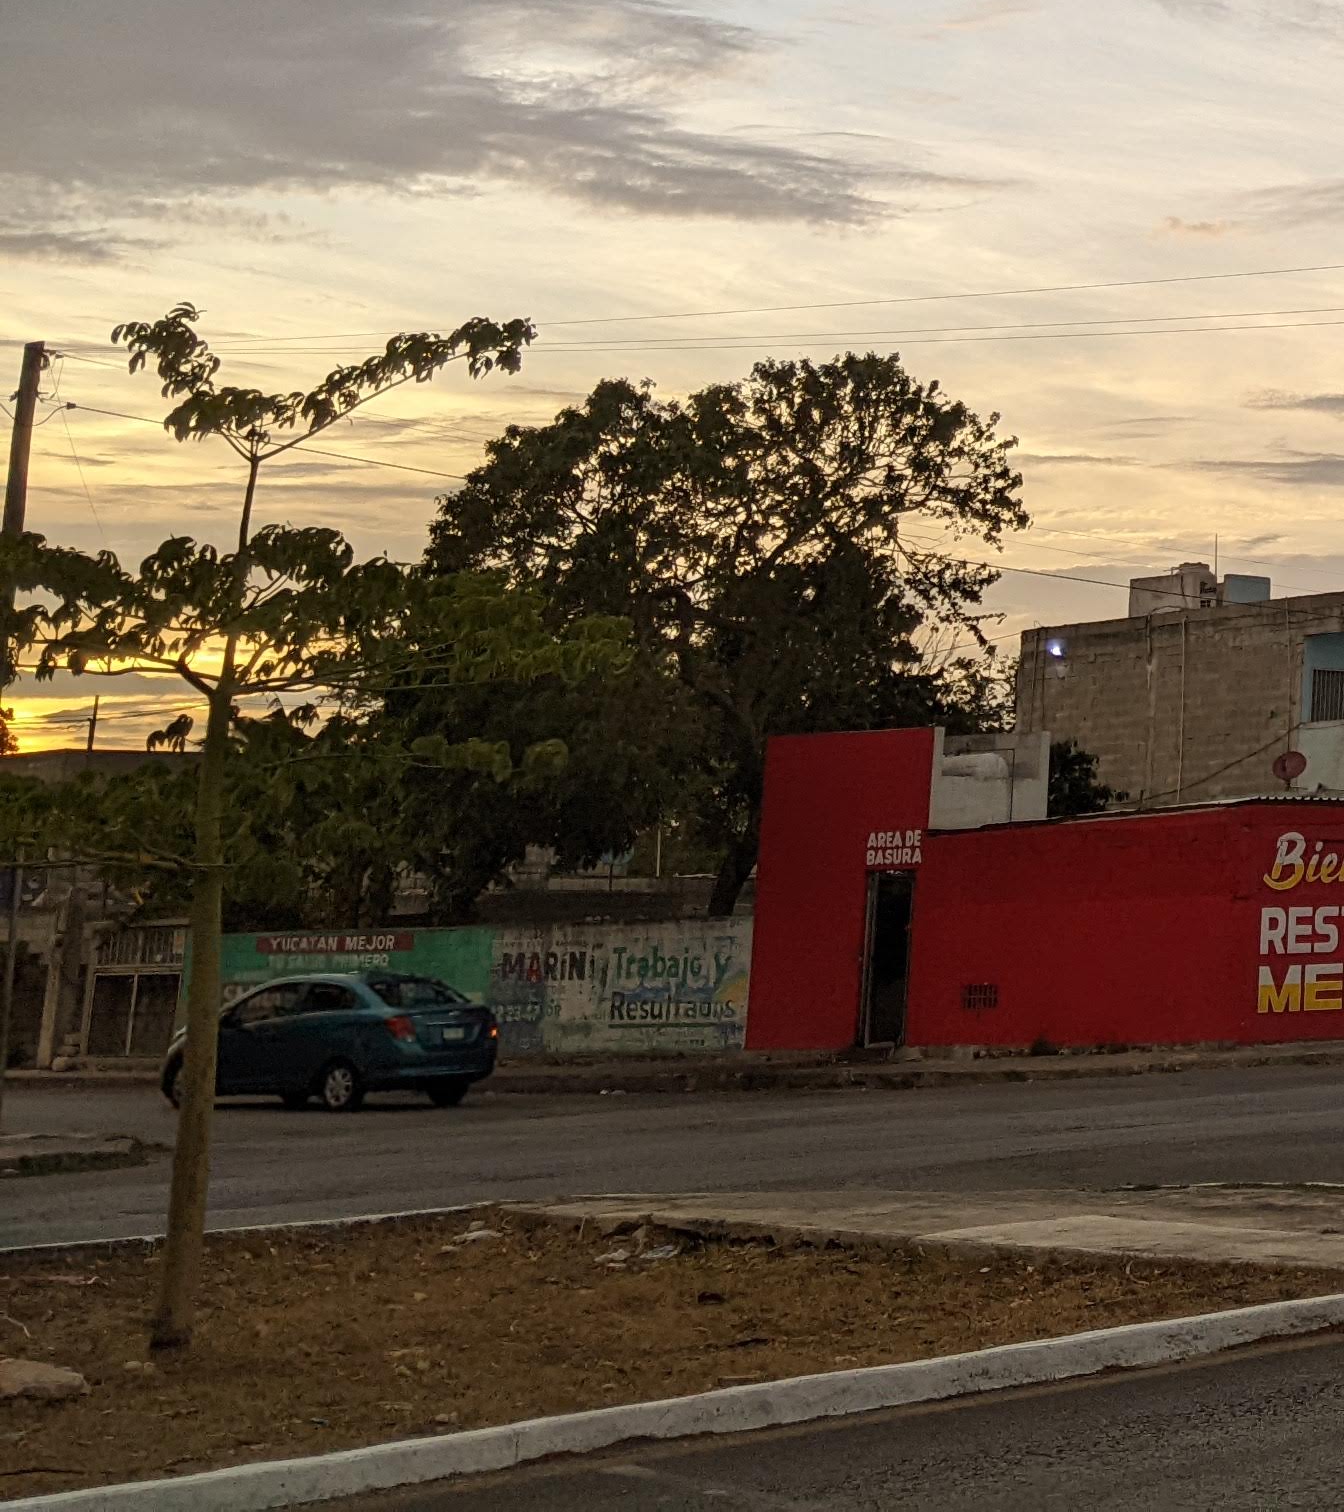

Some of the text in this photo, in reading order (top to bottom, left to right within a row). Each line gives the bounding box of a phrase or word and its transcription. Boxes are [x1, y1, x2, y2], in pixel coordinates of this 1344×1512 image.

[867, 829, 922, 848] AREA DE
[866, 848, 922, 865] BASURA
[345, 935, 395, 950] MEJOR
